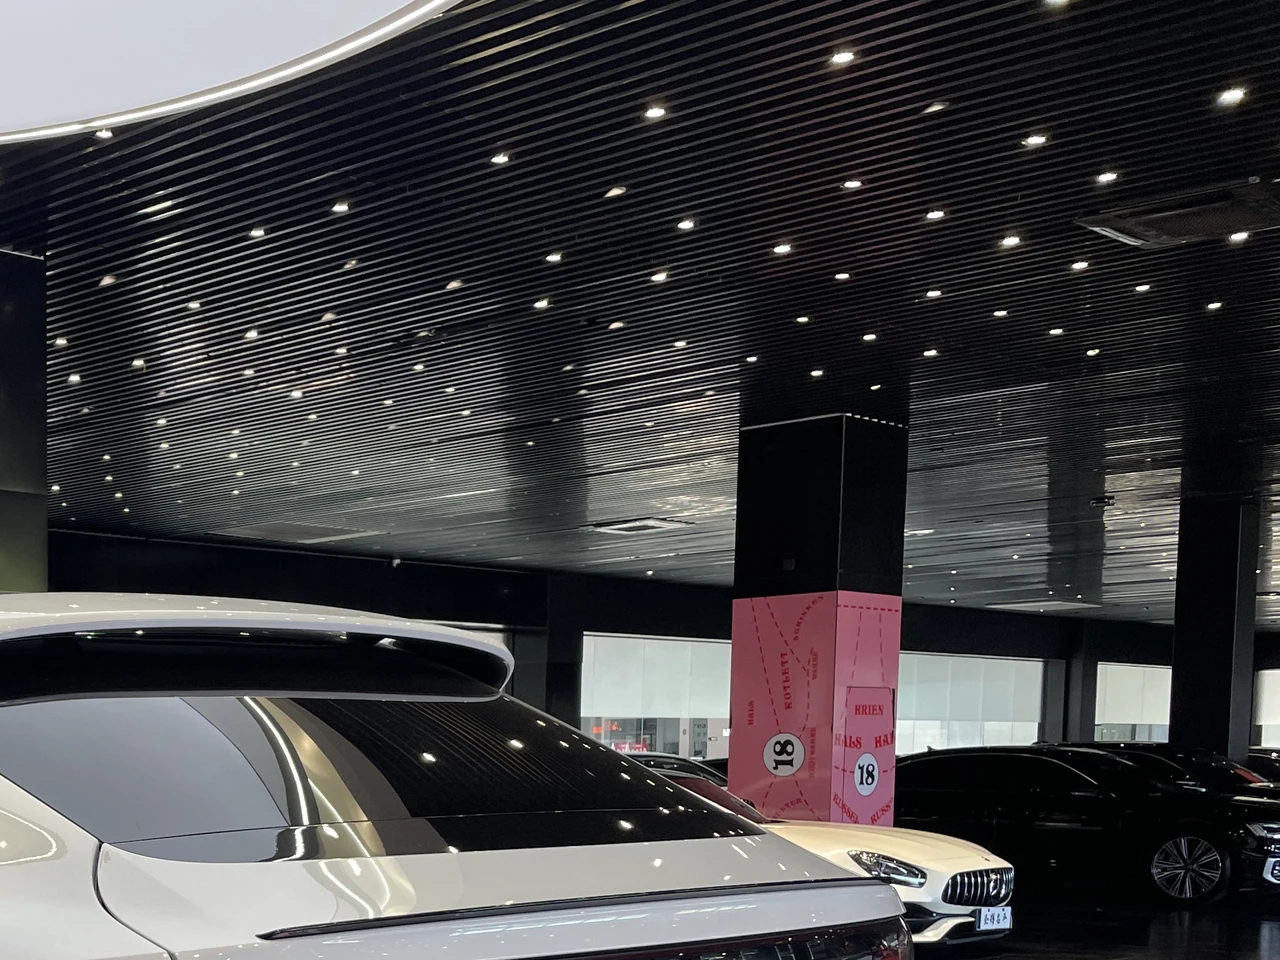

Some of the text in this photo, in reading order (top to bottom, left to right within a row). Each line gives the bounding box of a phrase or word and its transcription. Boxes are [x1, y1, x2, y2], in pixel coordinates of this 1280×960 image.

[834, 732, 863, 750] HALS
[773, 739, 795, 770] 18
[858, 763, 875, 786] 18
